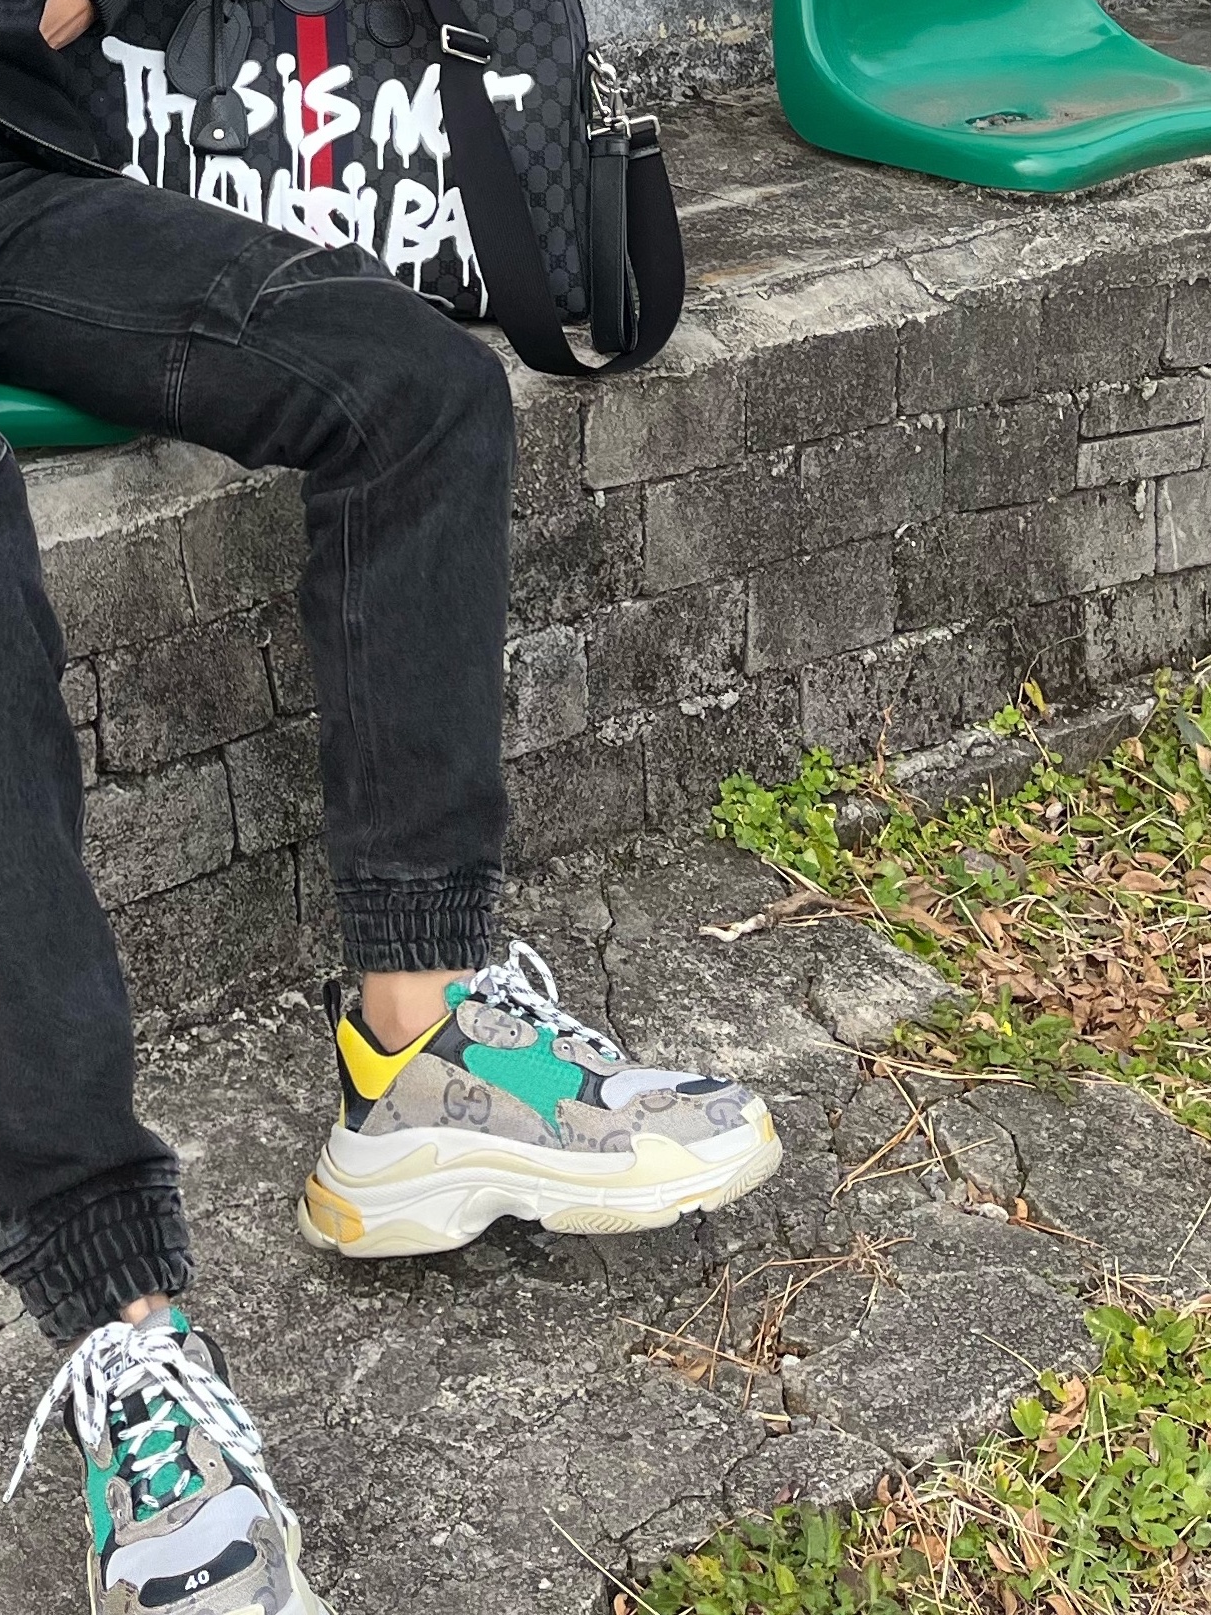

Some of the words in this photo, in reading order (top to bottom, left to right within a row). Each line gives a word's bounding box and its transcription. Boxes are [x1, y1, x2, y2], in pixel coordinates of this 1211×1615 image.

[101, 35, 277, 156] ThS
[380, 178, 488, 284] BA
[184, 1569, 210, 1591] 40
